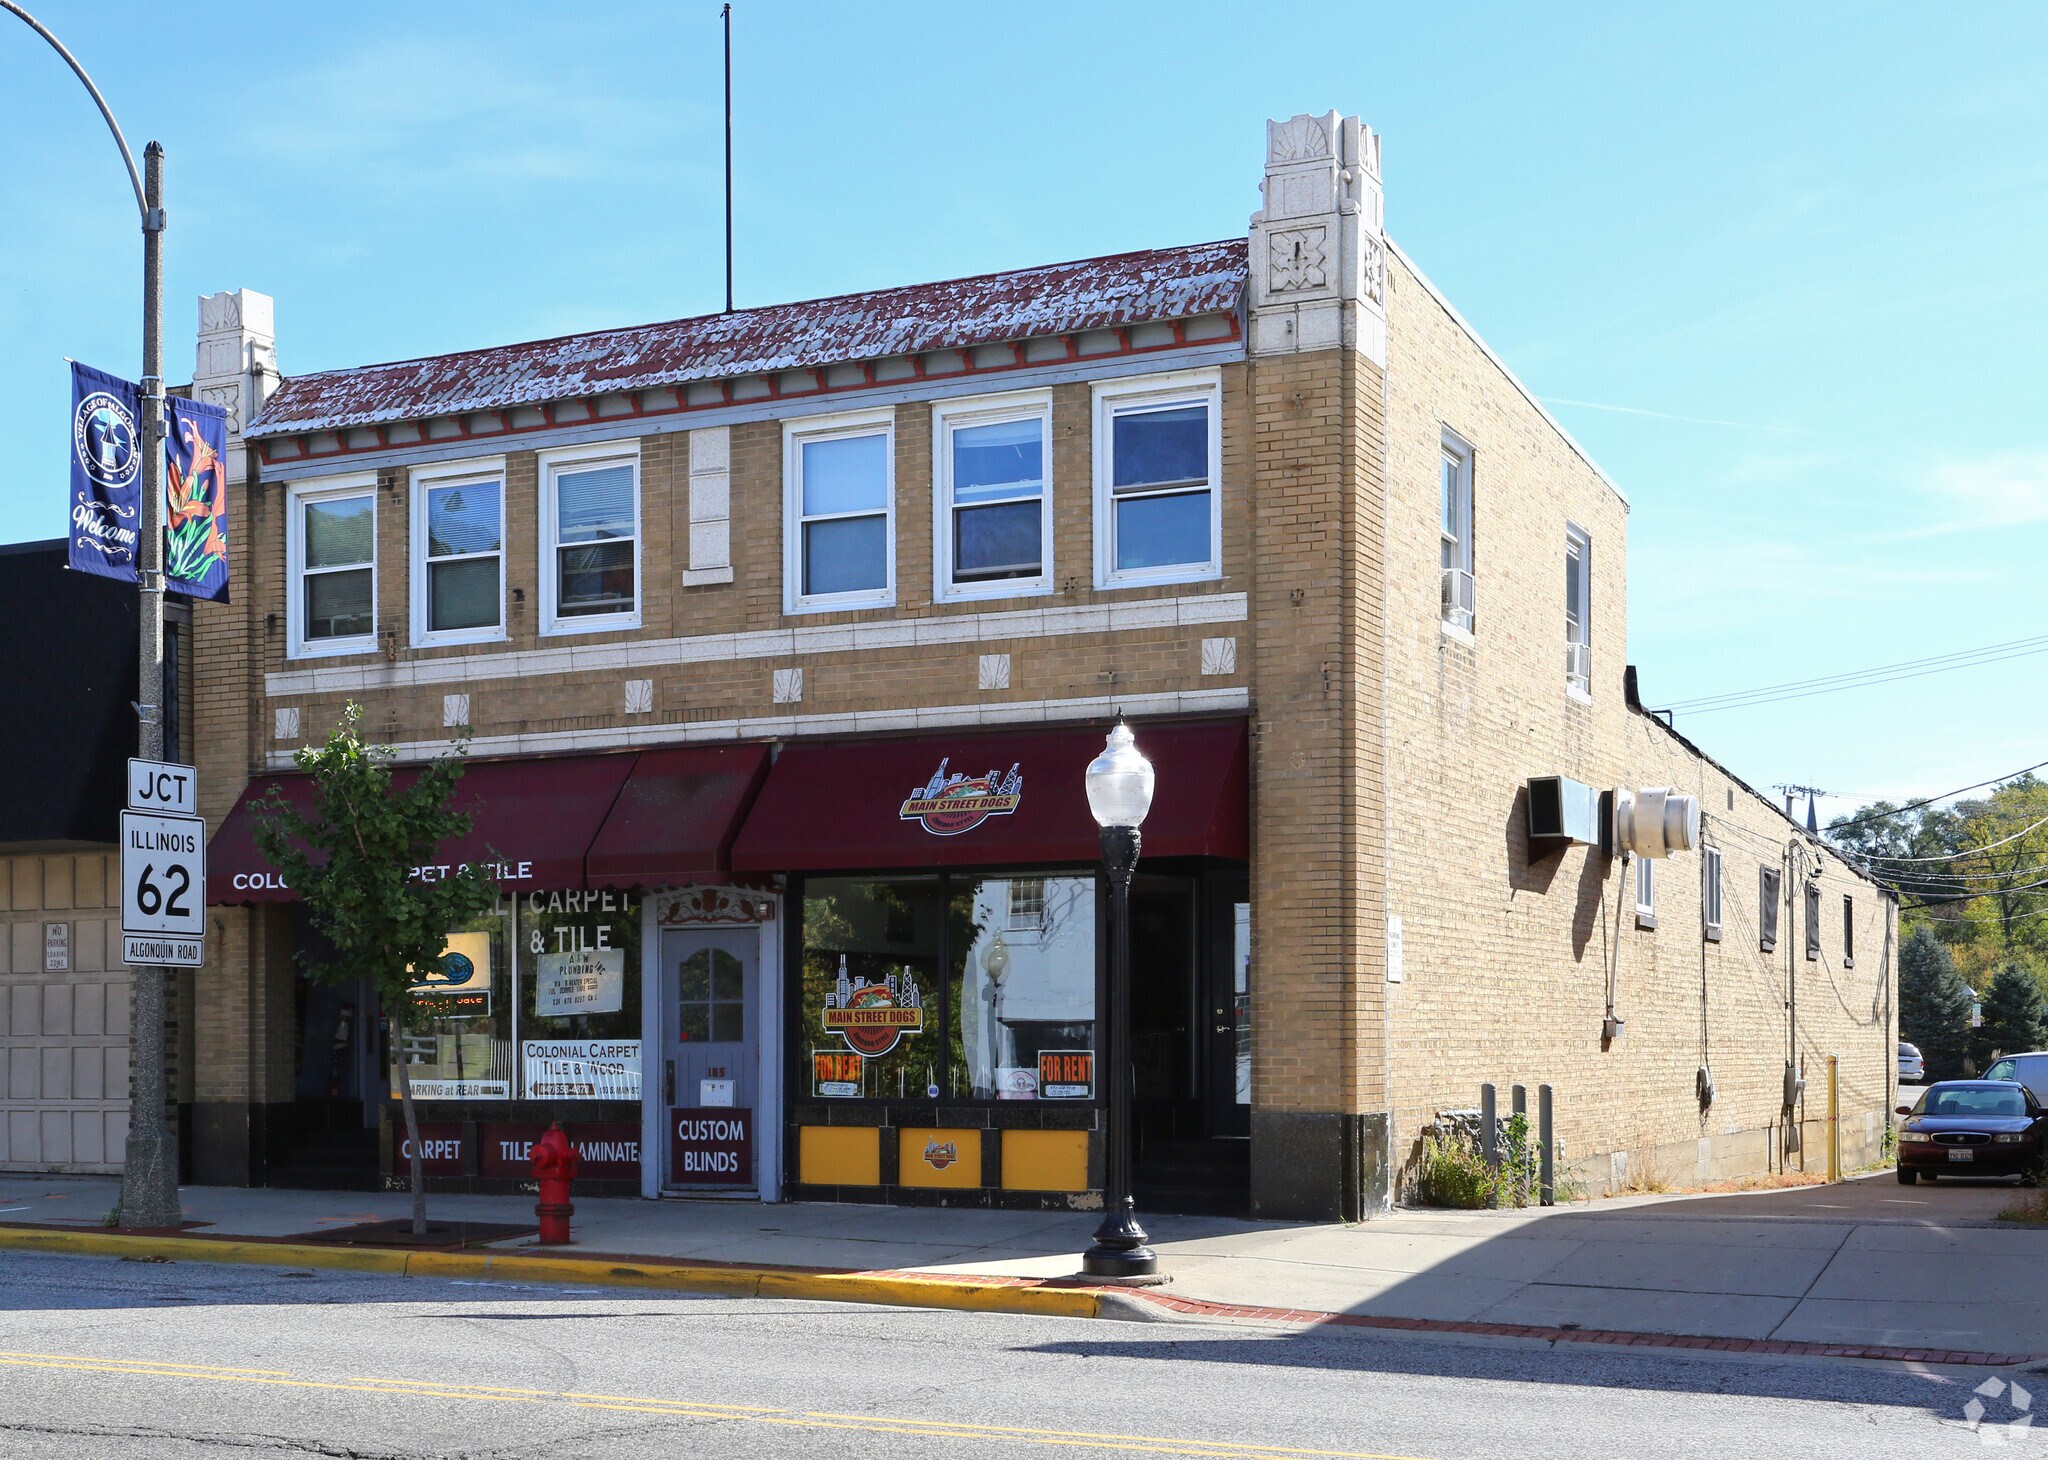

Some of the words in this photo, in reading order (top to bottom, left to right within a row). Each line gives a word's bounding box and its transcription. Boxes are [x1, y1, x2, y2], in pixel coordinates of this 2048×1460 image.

[72, 505, 136, 545] Welcome
[138, 771, 188, 804] JCT
[908, 803, 937, 812] MAIN
[939, 800, 979, 810] STREET
[980, 797, 1011, 808] DOGS
[131, 828, 195, 854] ILLINOIS
[136, 863, 190, 917] 62
[52, 926, 62, 936] NO
[530, 929, 545, 953] &
[553, 925, 612, 953] TILE
[47, 938, 67, 948] PARKING
[129, 942, 174, 959] ALGONQUIN
[177, 944, 198, 960] ROAD
[559, 964, 594, 976] PLUMBING
[828, 1010, 853, 1024] MAIN
[854, 1010, 888, 1024] STREET
[889, 1009, 916, 1023] DOGS
[526, 1043, 586, 1058] COLONIAL
[589, 1043, 639, 1058] CARPET
[541, 1060, 569, 1075] TILE
[573, 1062, 583, 1075] &
[587, 1060, 625, 1075] WOOD
[814, 1055, 834, 1081] FOR
[835, 1055, 862, 1082] RENT
[1040, 1055, 1061, 1082] FOR
[1063, 1055, 1092, 1082] RENT
[410, 1084, 443, 1096] ARKING
[444, 1086, 454, 1096] at
[455, 1085, 480, 1096] REAR
[678, 1120, 744, 1140] CUSTOM
[401, 1140, 461, 1160] CARPET
[500, 1141, 533, 1161] TILE
[569, 1141, 639, 1162] AMINATE
[684, 1151, 738, 1172] BLINDS
